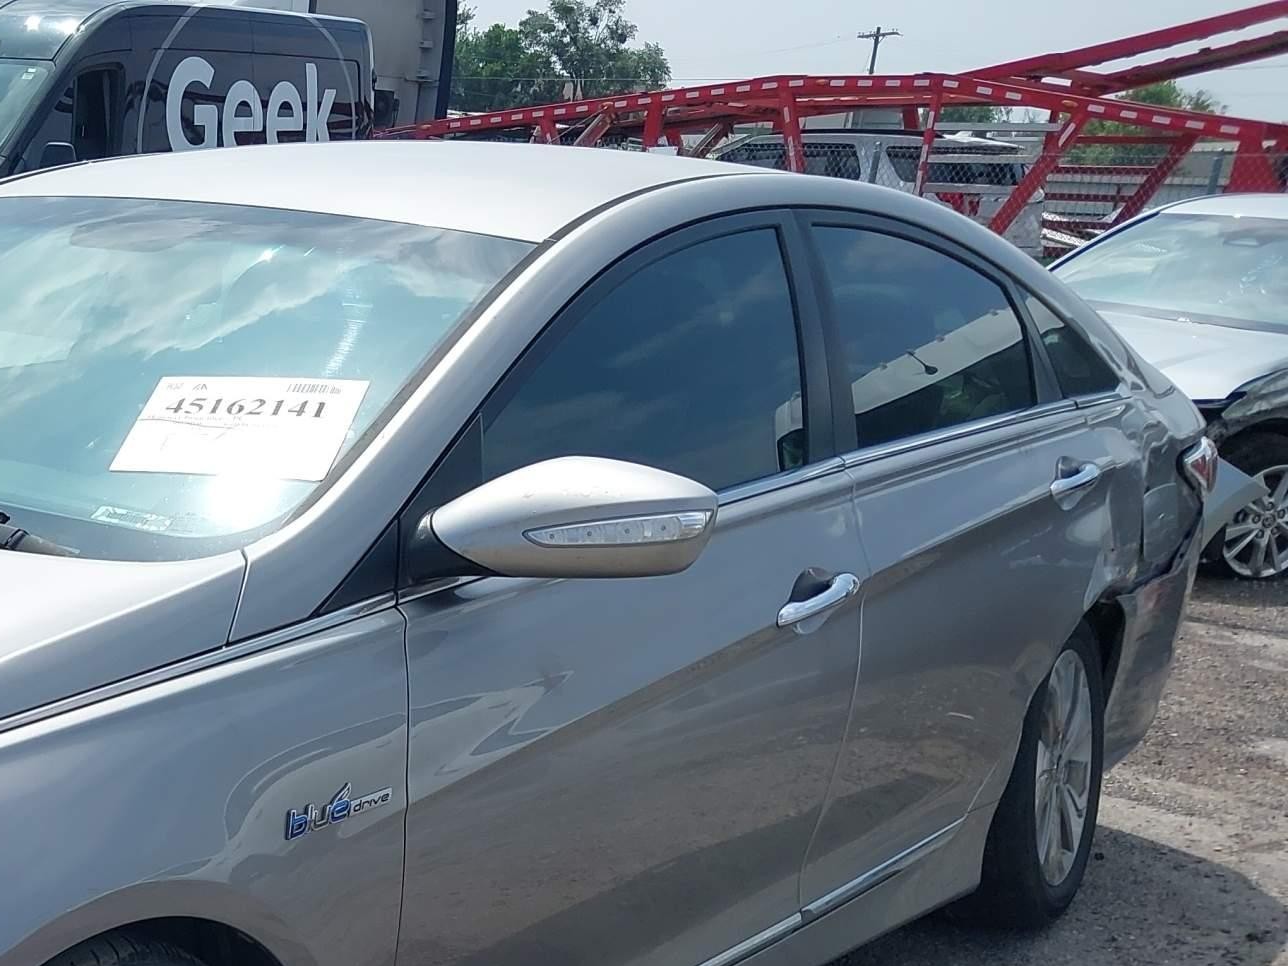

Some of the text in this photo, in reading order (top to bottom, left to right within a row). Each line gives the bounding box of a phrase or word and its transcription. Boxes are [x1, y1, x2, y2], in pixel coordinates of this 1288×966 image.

[166, 56, 337, 152] Geek
[165, 397, 327, 418] 45162141
[352, 792, 391, 813] drive
